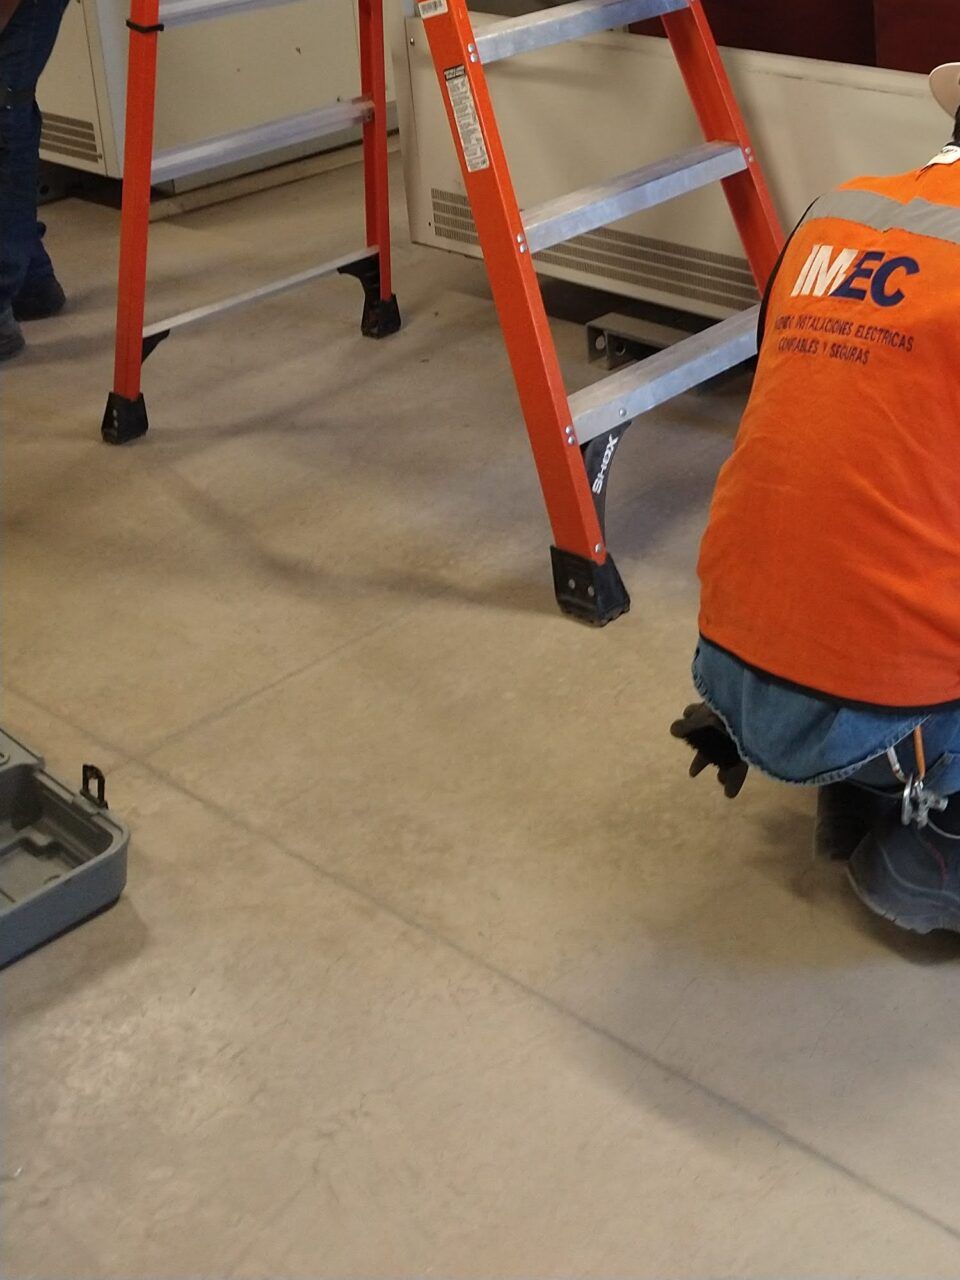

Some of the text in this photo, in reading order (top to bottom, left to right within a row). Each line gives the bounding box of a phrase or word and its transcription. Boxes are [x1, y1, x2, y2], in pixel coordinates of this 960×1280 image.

[790, 244, 920, 308] IMEC
[829, 342, 870, 365] SEGURAS
[855, 324, 914, 352] ELECTRICAS
[592, 433, 619, 494] SHOX
